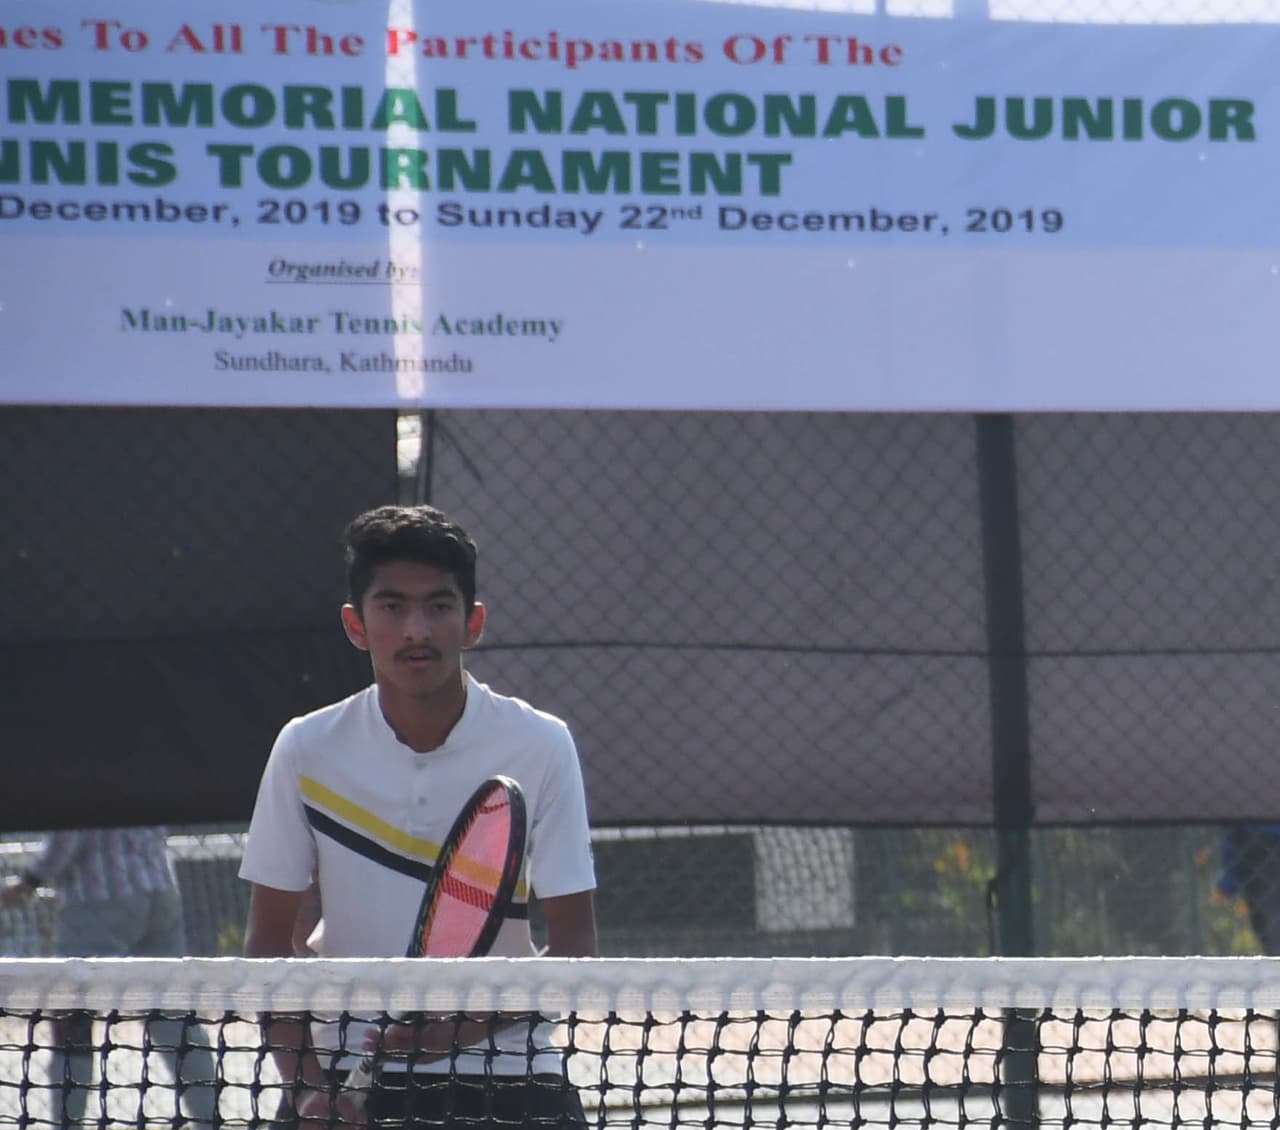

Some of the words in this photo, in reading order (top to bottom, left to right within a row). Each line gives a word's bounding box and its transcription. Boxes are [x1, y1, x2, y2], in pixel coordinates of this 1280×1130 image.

[0, 25, 64, 51] es
[80, 19, 149, 51] To
[166, 23, 244, 54] All
[260, 25, 365, 56] The
[386, 26, 704, 69] Participants
[723, 33, 792, 65] Of
[804, 34, 904, 66] The
[7, 78, 477, 133] MEMORIAL
[508, 89, 925, 139] NATIONAL
[952, 95, 1256, 142] JUNIOR
[206, 143, 793, 196] TOURNAMENT
[0, 193, 239, 227] December,
[256, 198, 361, 226] 2019
[378, 202, 419, 226] to
[437, 202, 604, 235] Sunday
[718, 205, 949, 237] December,
[965, 207, 1064, 233] 2019
[267, 257, 381, 281] Organised
[121, 307, 320, 339] Man-Jayakar
[328, 311, 423, 336] Tennis
[432, 312, 564, 342] Academy
[214, 350, 331, 373] Sundhara,
[340, 351, 473, 374] Kathmandu
